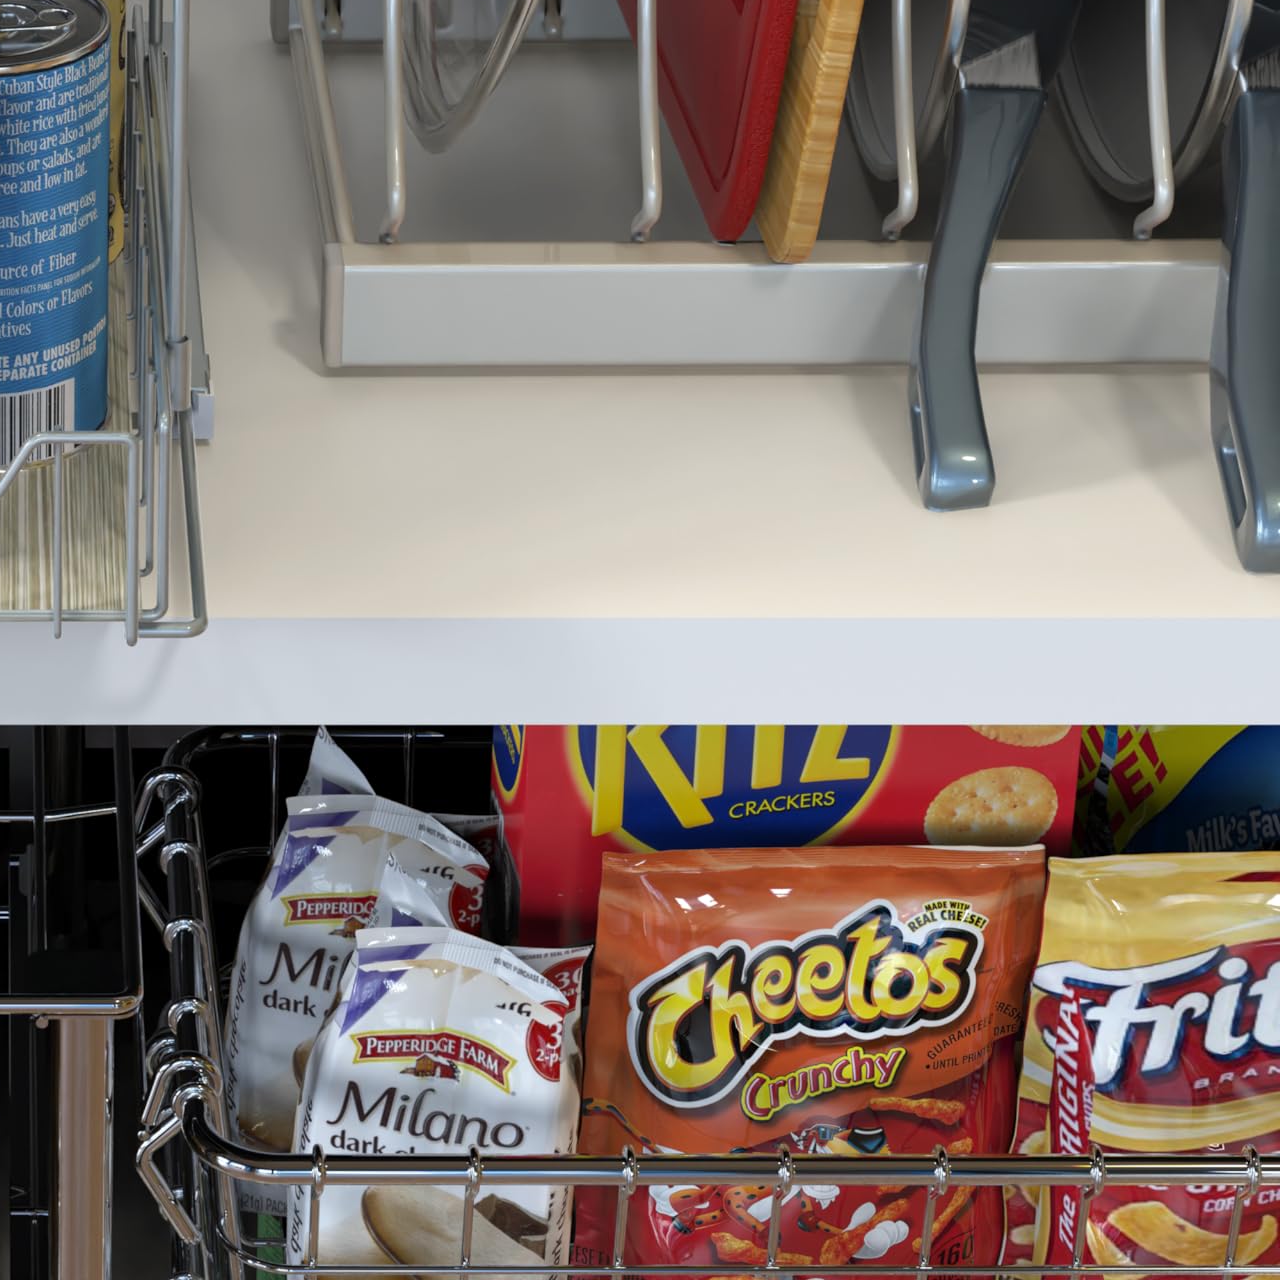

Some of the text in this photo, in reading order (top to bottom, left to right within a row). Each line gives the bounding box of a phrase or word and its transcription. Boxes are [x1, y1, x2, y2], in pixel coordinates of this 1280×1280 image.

[36, 70, 63, 93] Style
[64, 61, 87, 83] Black
[32, 115, 54, 132] rice
[55, 104, 77, 126] with
[78, 95, 96, 118] fried
[36, 92, 56, 111] and
[58, 89, 75, 105] are
[6, 138, 37, 156] They
[40, 134, 57, 151] are
[59, 126, 78, 145] also
[79, 127, 84, 138] a
[27, 158, 40, 172] or
[76, 137, 91, 158] and
[19, 175, 42, 193] and
[44, 172, 62, 190] low
[63, 168, 73, 183] in
[21, 209, 49, 227] have
[50, 207, 56, 220] a
[57, 200, 79, 217] very
[79, 190, 97, 208] easy
[6, 217, 78, 248] Just heat and
[31, 258, 45, 276] of
[49, 251, 77, 273] Fiber
[6, 299, 45, 318] Colors
[47, 297, 59, 311] or
[61, 281, 93, 306] Flavors
[20, 284, 37, 294] FACTS
[37, 281, 53, 291] PANEL
[14, 351, 39, 368] ANY
[43, 338, 80, 362] UNUSED
[51, 340, 97, 372] CONTAINER
[729, 790, 837, 819] CRACKERS
[907, 910, 937, 933] REAL
[925, 900, 970, 912] MADE WITH
[513, 965, 539, 983] PURCHASE
[263, 987, 317, 1018] dark
[647, 913, 968, 1090] Cheetos
[365, 1036, 500, 1075] PEPPERIDGE FARM
[932, 1024, 1017, 1071] UNTIL DATE
[746, 1049, 905, 1117] Crunchy
[326, 1080, 525, 1149] Milano
